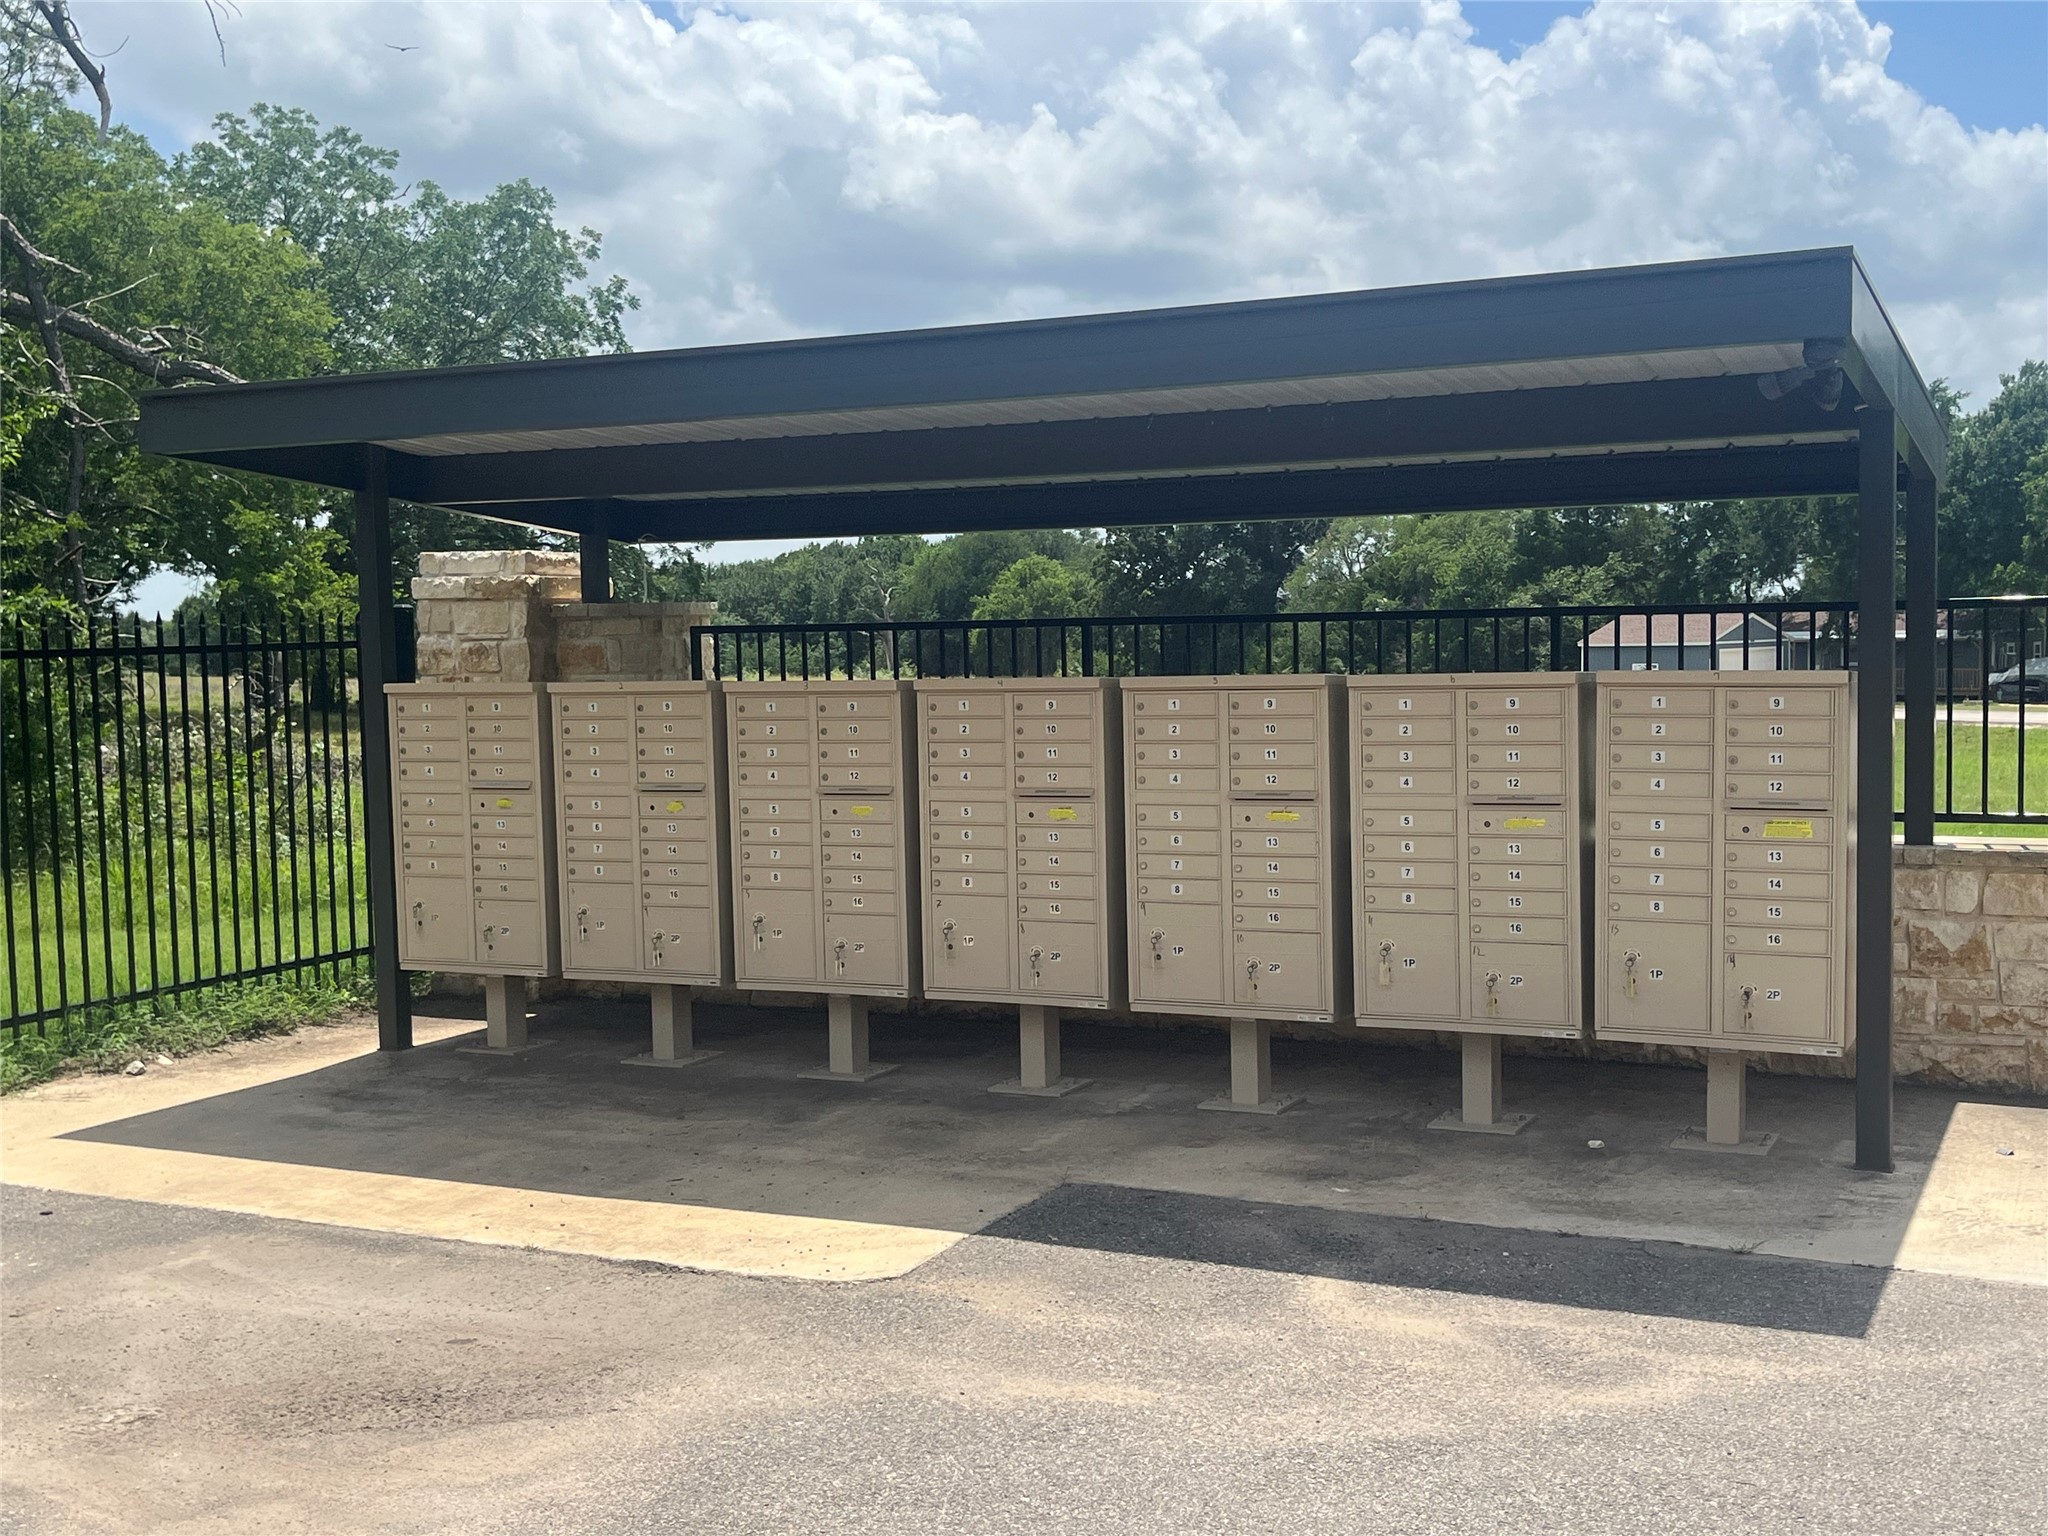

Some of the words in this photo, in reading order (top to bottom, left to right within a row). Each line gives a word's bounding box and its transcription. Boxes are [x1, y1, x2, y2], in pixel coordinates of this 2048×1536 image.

[1267, 699, 1273, 708] 9
[1509, 699, 1516, 708] 9
[1773, 698, 1780, 708] 9
[849, 726, 858, 734] 10
[1047, 725, 1056, 733] 10
[1172, 725, 1177, 734] 2
[1266, 725, 1276, 733] 10
[1403, 726, 1409, 735] 2
[1507, 725, 1519, 734] 10
[1655, 725, 1662, 734] 2
[1770, 726, 1783, 736] 10
[1048, 749, 1057, 757] 11
[1172, 750, 1178, 759] 3
[1266, 750, 1276, 758] 11
[1403, 752, 1409, 761] 3
[1508, 752, 1519, 761] 11
[1655, 752, 1661, 762] 3
[1771, 755, 1782, 763] 11
[850, 772, 859, 780] 12
[1048, 773, 1058, 781] 12
[1172, 775, 1178, 783] 4
[1267, 775, 1277, 784] 12
[1403, 778, 1409, 786] 4
[1508, 778, 1519, 787] 12
[1654, 780, 1661, 788] 4
[1770, 782, 1782, 791] 12
[1173, 811, 1179, 820] 5
[1404, 817, 1410, 825] 5
[1655, 821, 1661, 829] 5
[852, 829, 861, 837] 13
[1049, 833, 1059, 841] 13
[1174, 836, 1179, 844] 6
[1267, 838, 1278, 847] 13
[1404, 842, 1411, 851] 6
[1509, 844, 1520, 854] 13
[1654, 848, 1661, 857] 6
[1769, 852, 1782, 861] 13
[1049, 857, 1059, 865] 14
[1174, 861, 1180, 869] 7
[1268, 863, 1278, 871] 14
[1405, 868, 1411, 876] 7
[1509, 871, 1520, 880] 14
[853, 875, 862, 883] 15
[1654, 875, 1660, 884] 7
[1050, 880, 1060, 889] 15
[1769, 880, 1781, 888] 14
[1175, 885, 1180, 894] 8
[1269, 888, 1279, 897] 15
[1405, 894, 1412, 903] 8
[1509, 898, 1521, 906] 15
[1050, 904, 1060, 912] 16
[1654, 902, 1660, 911] 8
[1769, 907, 1781, 917] 15
[1269, 913, 1279, 922] 16
[1510, 924, 1522, 932] 16
[772, 929, 782, 937] 1P
[1768, 935, 1781, 944] 16
[854, 943, 864, 951] 2P
[1050, 952, 1061, 960] 2P
[1269, 963, 1280, 972] 2P
[1404, 959, 1416, 967] 1P
[1650, 970, 1663, 979] 1P
[1510, 976, 1523, 985] 2P
[1767, 990, 1780, 999] 2P
